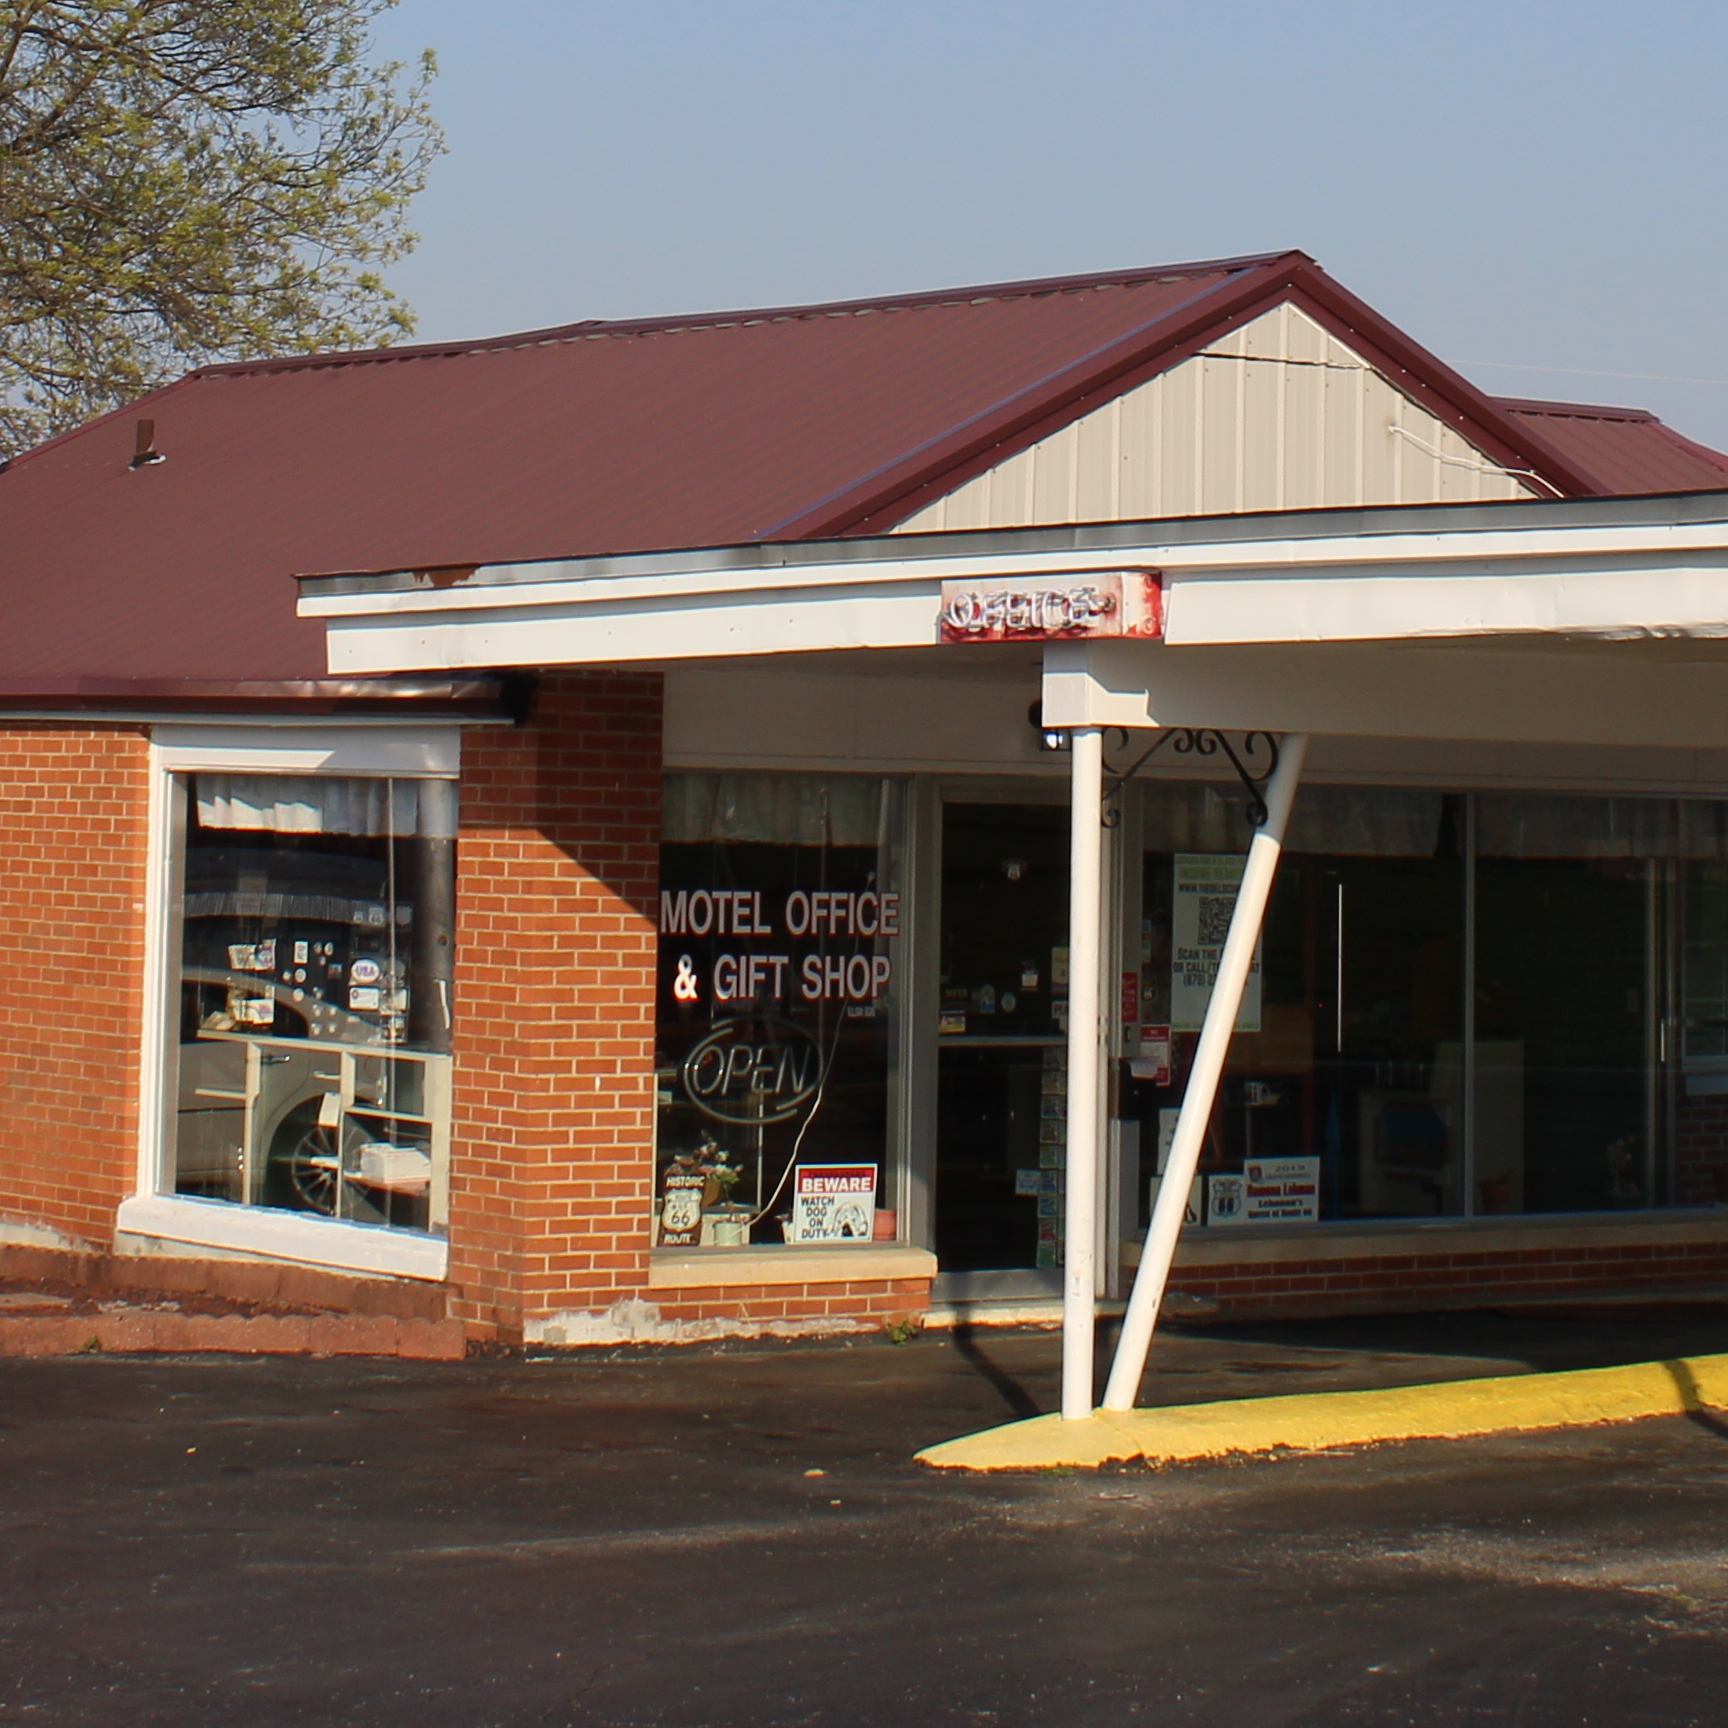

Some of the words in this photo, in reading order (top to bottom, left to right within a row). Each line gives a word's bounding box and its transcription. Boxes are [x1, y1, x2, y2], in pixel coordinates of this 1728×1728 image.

[660, 890, 772, 935] MOTEL
[785, 890, 900, 936] OFFICE
[673, 954, 699, 1000] &
[714, 954, 789, 1000] GIFT
[802, 954, 891, 1000] SHOP
[693, 1044, 811, 1095] OPEN
[666, 1175, 705, 1188] HISTORIC
[802, 1177, 872, 1193] BEWARE
[801, 1195, 834, 1207] WATCH
[671, 1209, 690, 1226] 66
[806, 1207, 828, 1217] DOG
[809, 1218, 824, 1228] ON
[801, 1228, 829, 1240] DUTY
